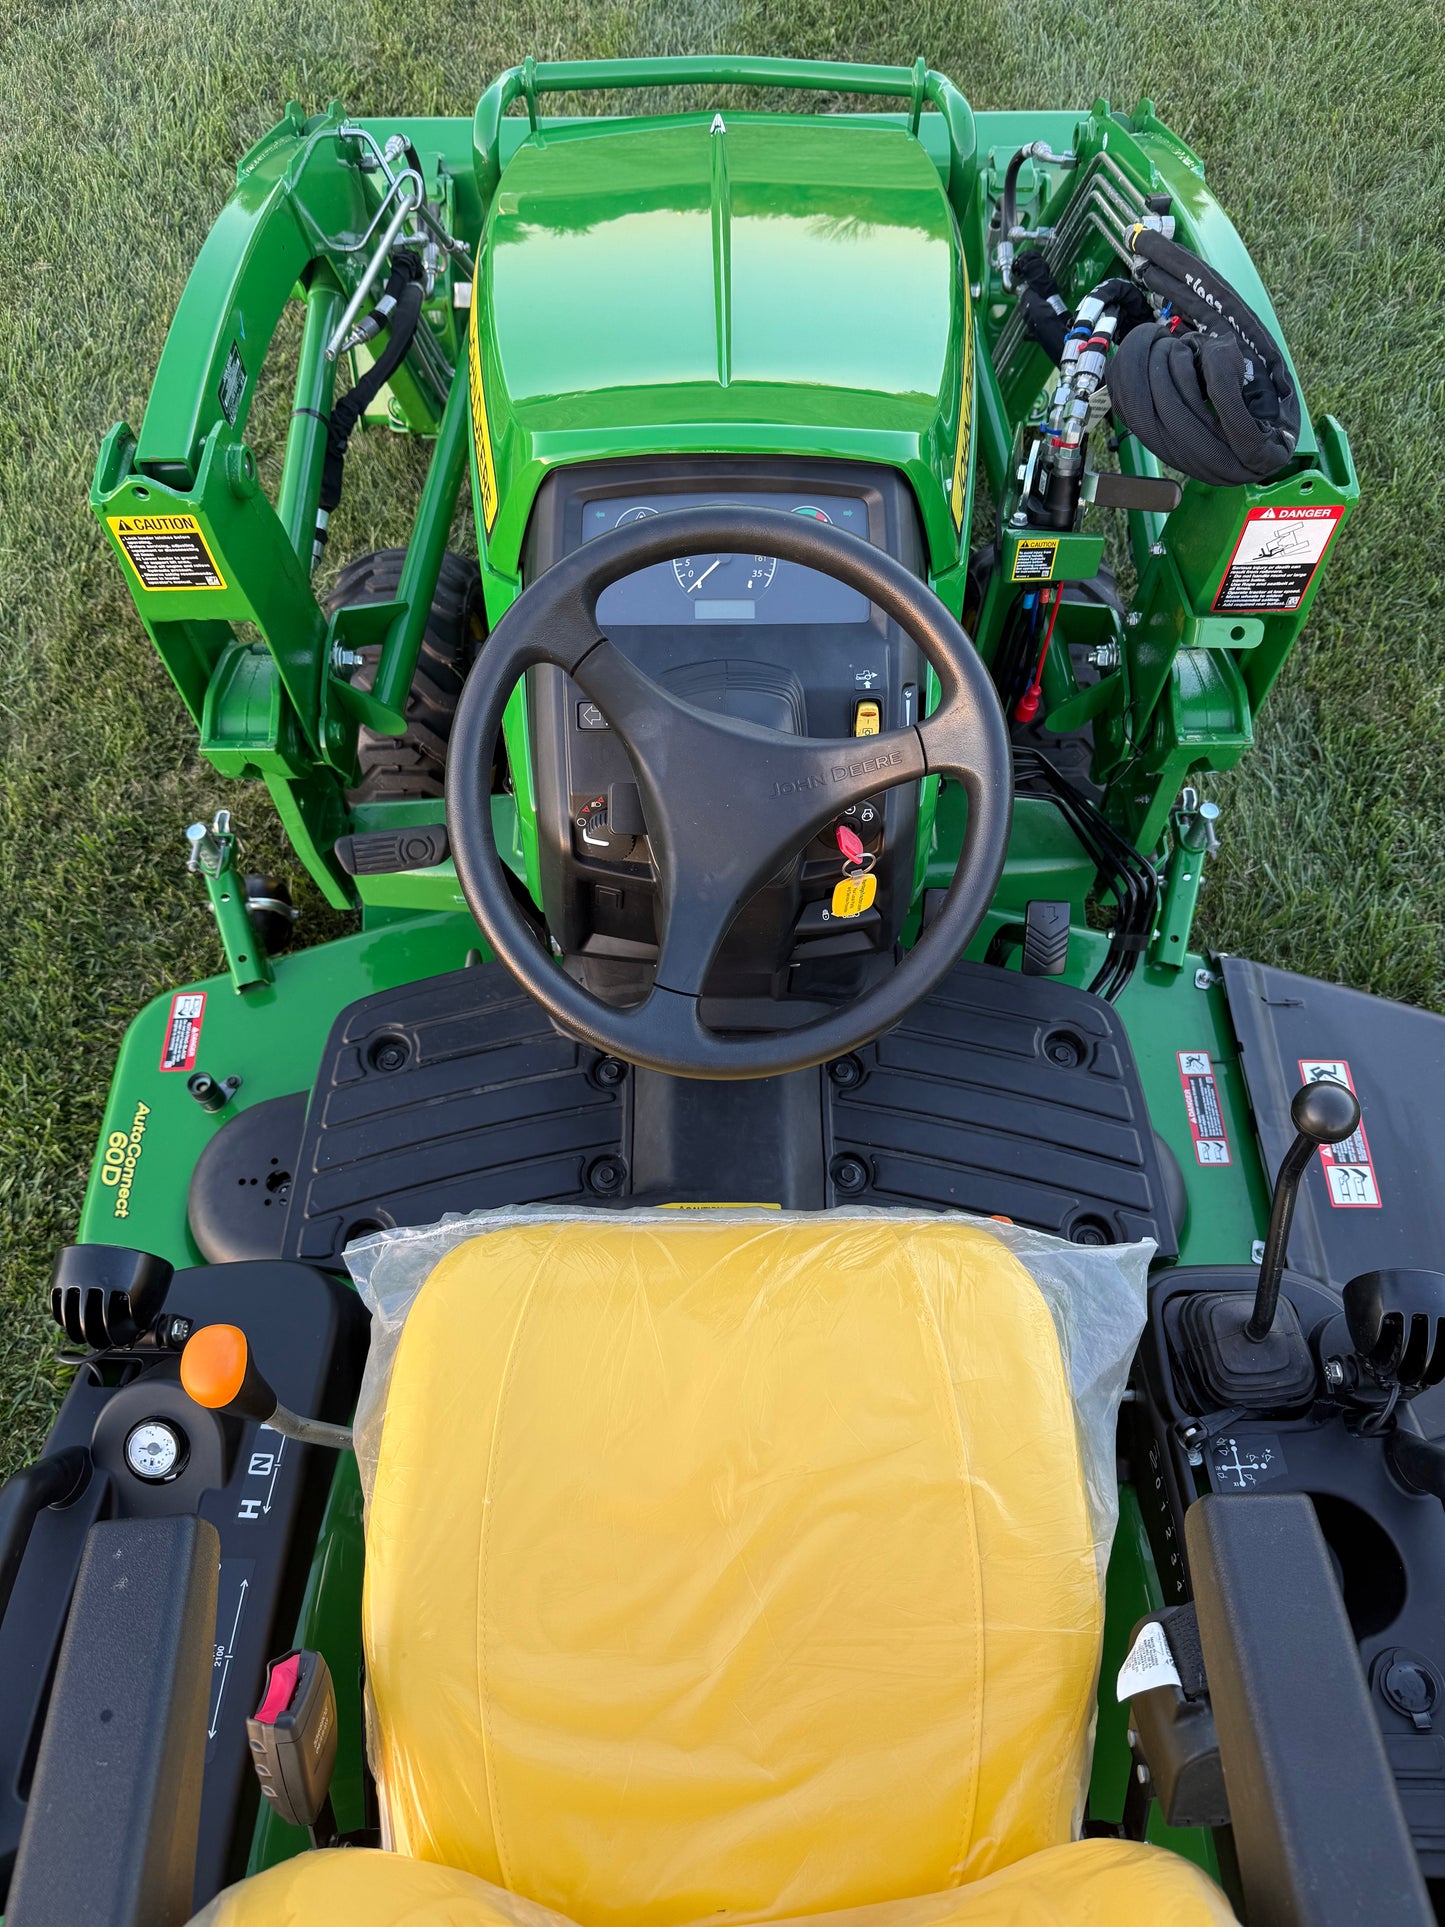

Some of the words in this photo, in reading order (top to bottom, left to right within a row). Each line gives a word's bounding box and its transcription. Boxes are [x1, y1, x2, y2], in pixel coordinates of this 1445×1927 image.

[1278, 509, 1331, 518] DANGER
[134, 518, 194, 530] CAUTION
[684, 558, 690, 566] 5
[688, 570, 694, 578] 0
[769, 776, 828, 799] JOHN
[831, 751, 902, 782] DEERE
[188, 1033, 198, 1057] DANGER
[101, 1132, 128, 1186] 60D
[113, 1100, 150, 1218] AutoConnect
[249, 1455, 273, 1473] N
[238, 1500, 261, 1518] H
[214, 1646, 225, 1667] 2100
